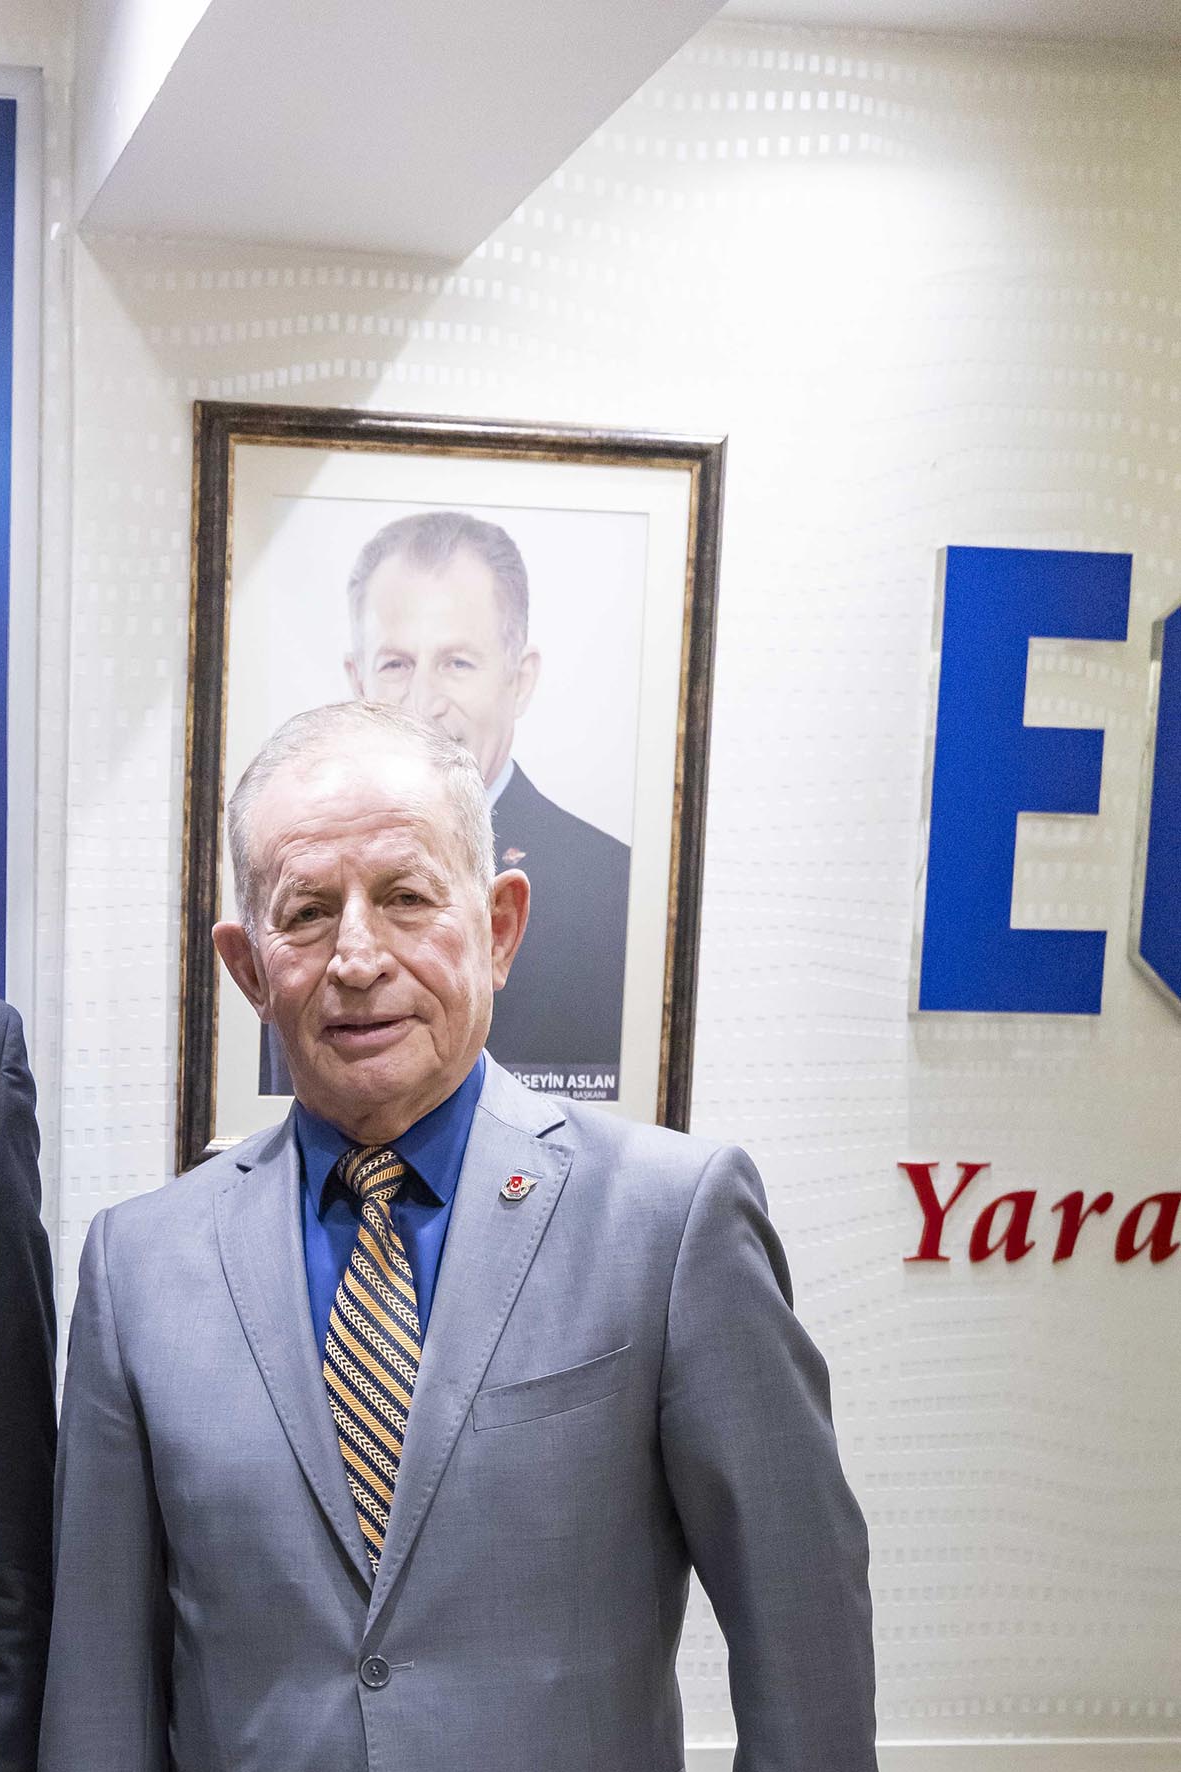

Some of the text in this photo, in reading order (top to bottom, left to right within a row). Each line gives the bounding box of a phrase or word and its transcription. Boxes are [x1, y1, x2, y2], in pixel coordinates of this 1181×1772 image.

[911, 545, 1181, 1019] E
[566, 1074, 615, 1089] ASLAN
[897, 1161, 1181, 1265] Yara
